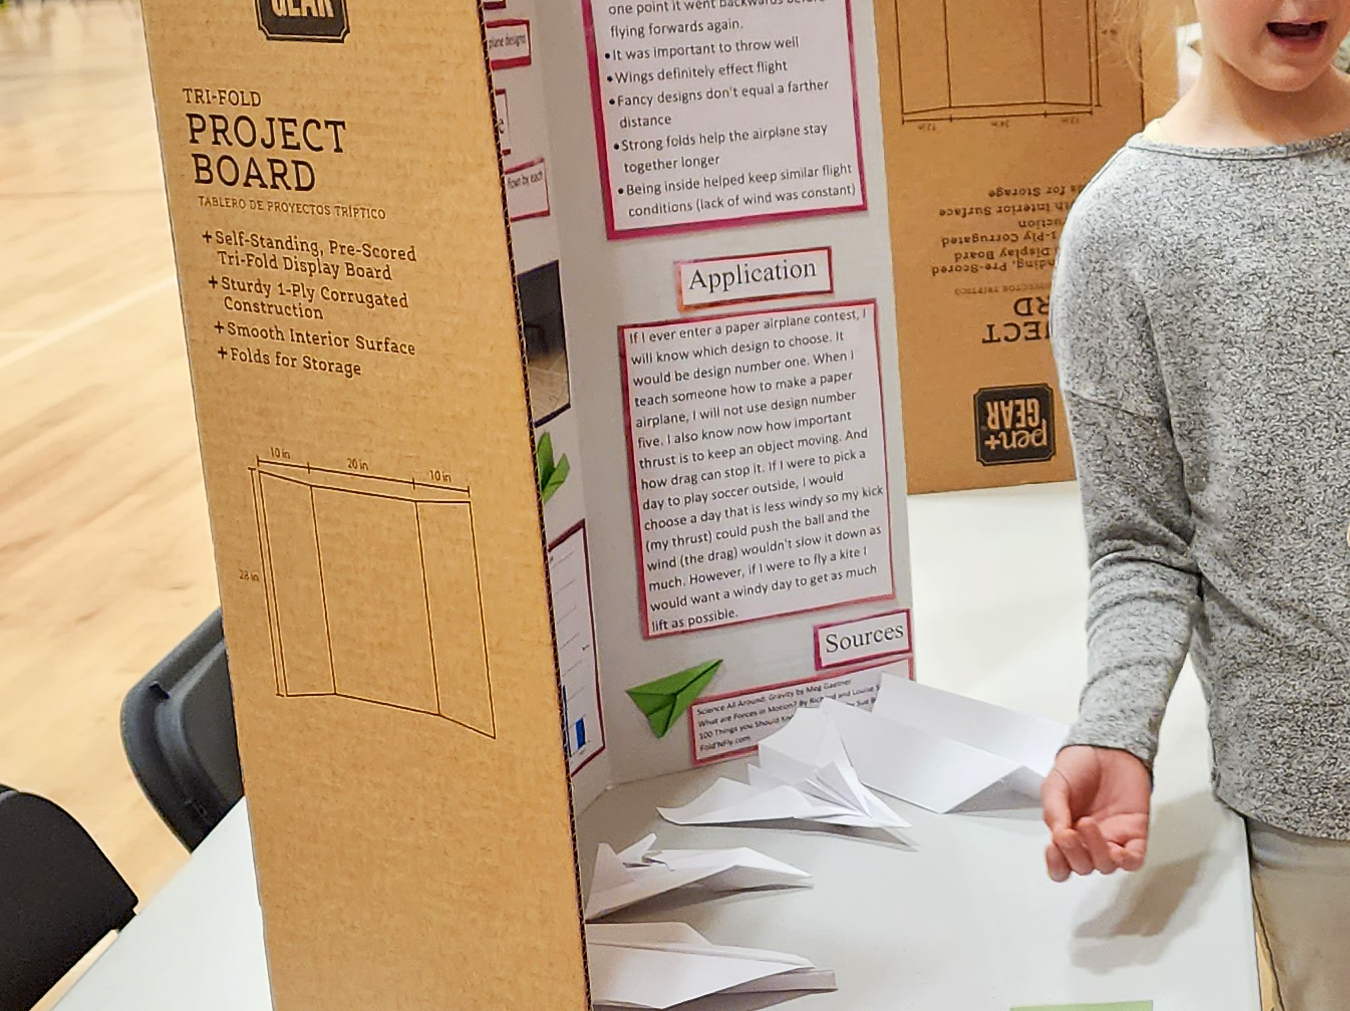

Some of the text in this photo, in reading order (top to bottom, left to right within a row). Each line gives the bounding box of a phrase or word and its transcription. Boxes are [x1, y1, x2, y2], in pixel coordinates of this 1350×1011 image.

[608, 5, 633, 15] one
[636, 1, 669, 16] point
[673, 0, 681, 11] it
[610, 20, 743, 40] flying forwards again.
[613, 36, 799, 61] It was important to throw well
[614, 60, 787, 85] Wings definitely effect flight
[182, 87, 261, 107] TRI-FOLD
[617, 80, 828, 107] Fancy designs don't equal a farther
[185, 113, 346, 153] PROJECT
[619, 116, 671, 129] distance
[621, 125, 827, 152] Strong folds help the airplane stay
[191, 153, 315, 191] BOARD
[624, 156, 719, 175] together longer
[626, 163, 852, 196] Being inside helped keep similar flight
[197, 195, 246, 209] TABLERO
[249, 200, 264, 211] DE
[266, 201, 331, 216] PROYECTOS
[628, 183, 855, 217] conditions (lack of wind was constant)
[215, 230, 417, 262] Self-Standing, Pre-Scored
[217, 250, 392, 281] Tri-Fold Display Board
[689, 260, 816, 293] Application
[221, 276, 409, 309] Sturdy 1-Ply Corrugated
[224, 296, 324, 320] Construction
[227, 322, 416, 356] Smooth Interior Surface
[630, 308, 866, 344] If I ever enter a paper airplane contest, I
[230, 347, 362, 378] Folds for Storage
[985, 398, 1041, 430] GEAR
[270, 446, 291, 459] 10 in
[347, 458, 369, 471] 20 in
[429, 470, 452, 483] 10 in
[652, 607, 738, 632] lift as possible.
[825, 623, 904, 653] Sources
